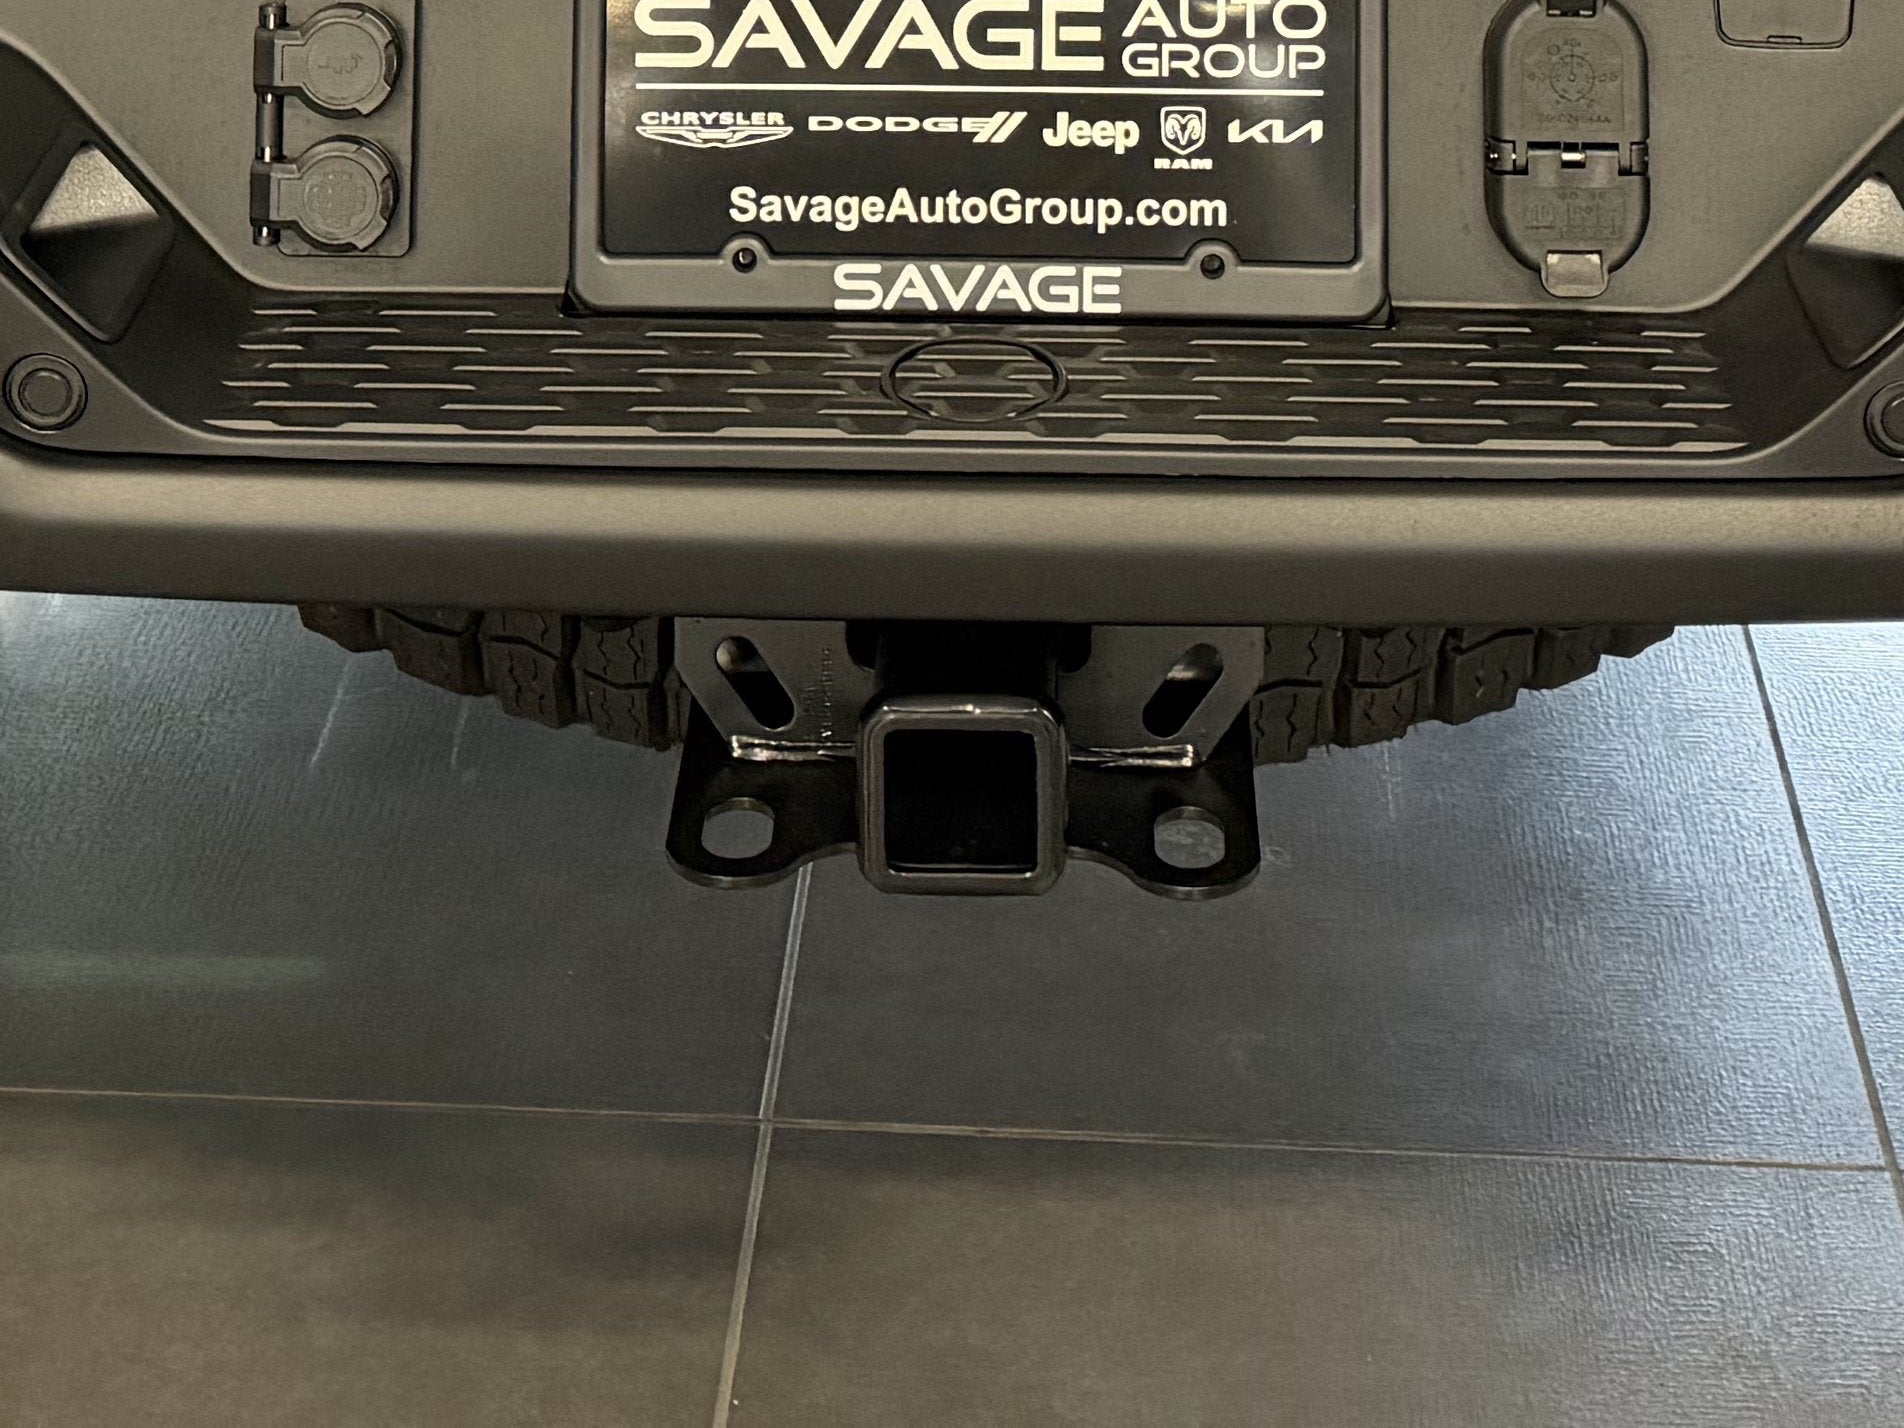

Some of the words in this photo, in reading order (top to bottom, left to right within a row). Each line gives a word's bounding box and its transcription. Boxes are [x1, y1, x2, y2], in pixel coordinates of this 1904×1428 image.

[1120, 41, 1326, 79] GROUP
[640, 111, 786, 127] CHRYSLER
[807, 114, 992, 133] DODGE
[1042, 110, 1140, 155] Jeep
[1153, 157, 1213, 170] RAM
[728, 185, 1228, 234] SavageAutoGroup.com
[833, 262, 1122, 314] SAVAGE
